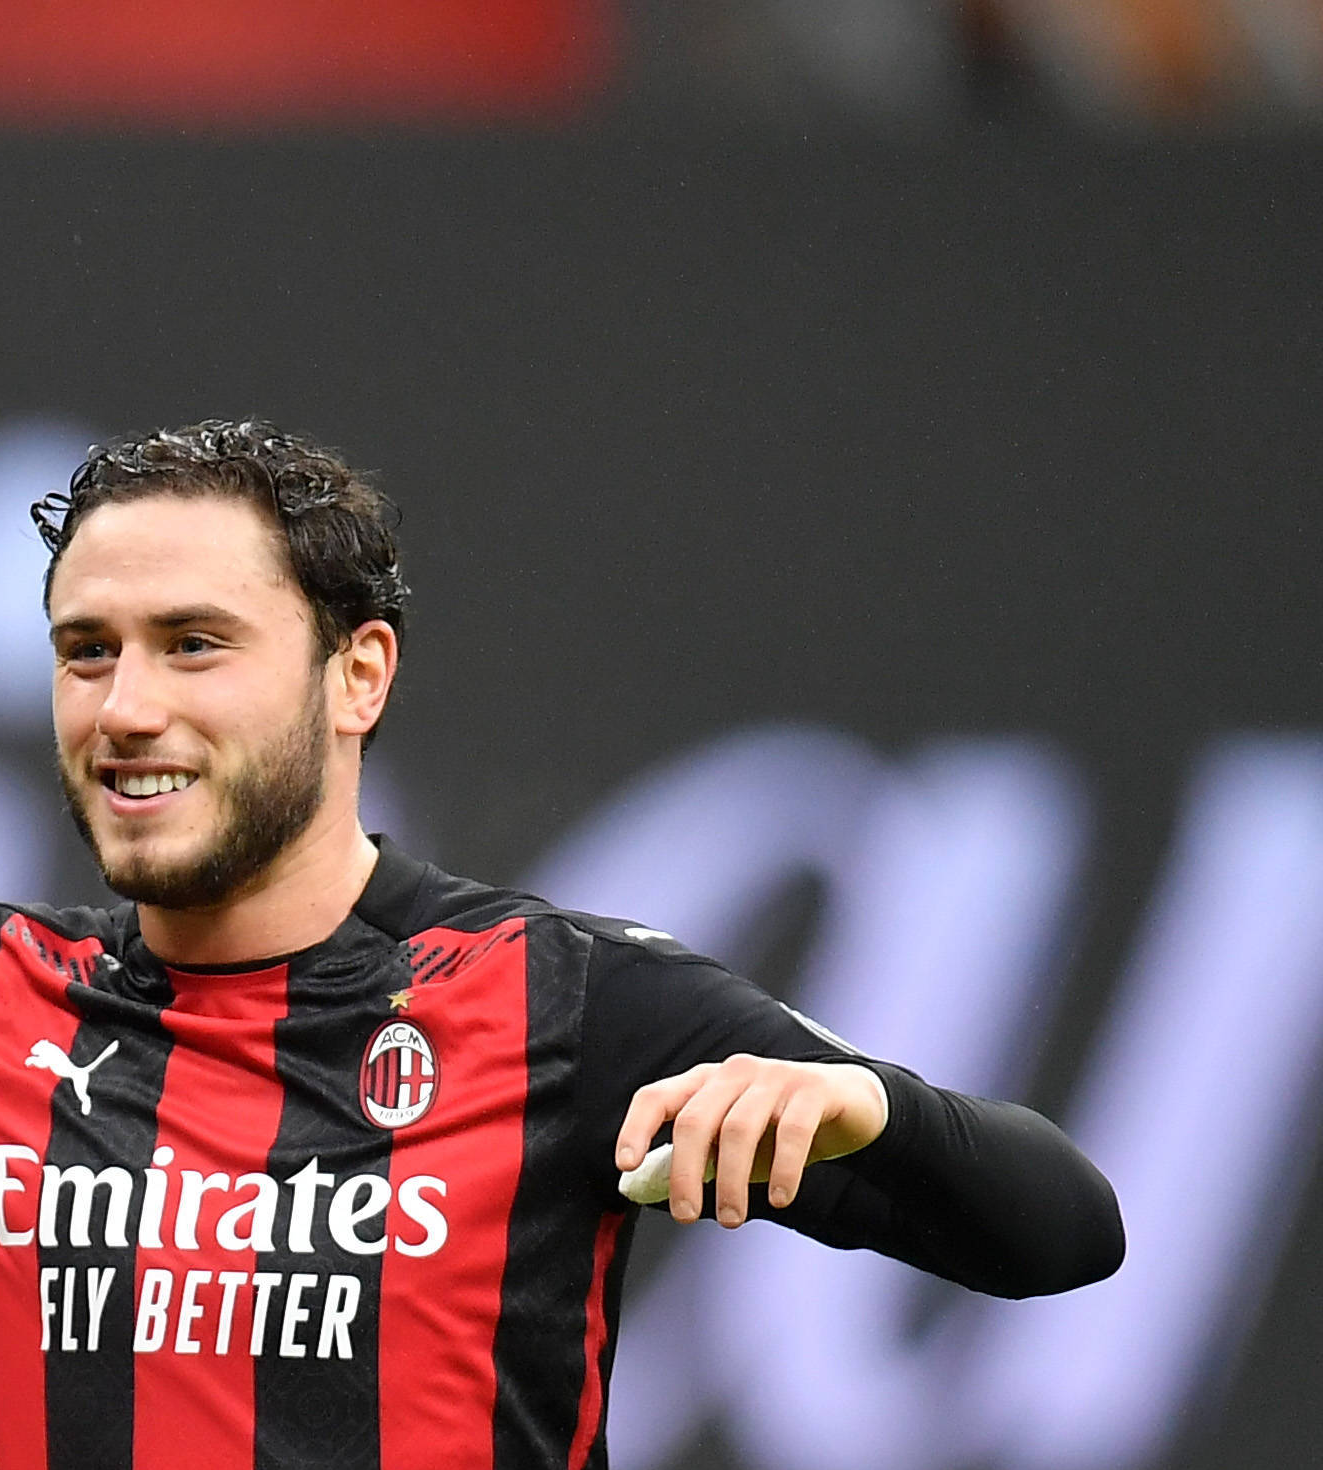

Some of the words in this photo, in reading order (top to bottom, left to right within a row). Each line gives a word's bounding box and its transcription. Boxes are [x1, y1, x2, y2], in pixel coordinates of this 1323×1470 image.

[378, 1026, 423, 1050] ACM
[39, 1266, 116, 1352] FLY
[131, 1267, 362, 1360] BETTER
